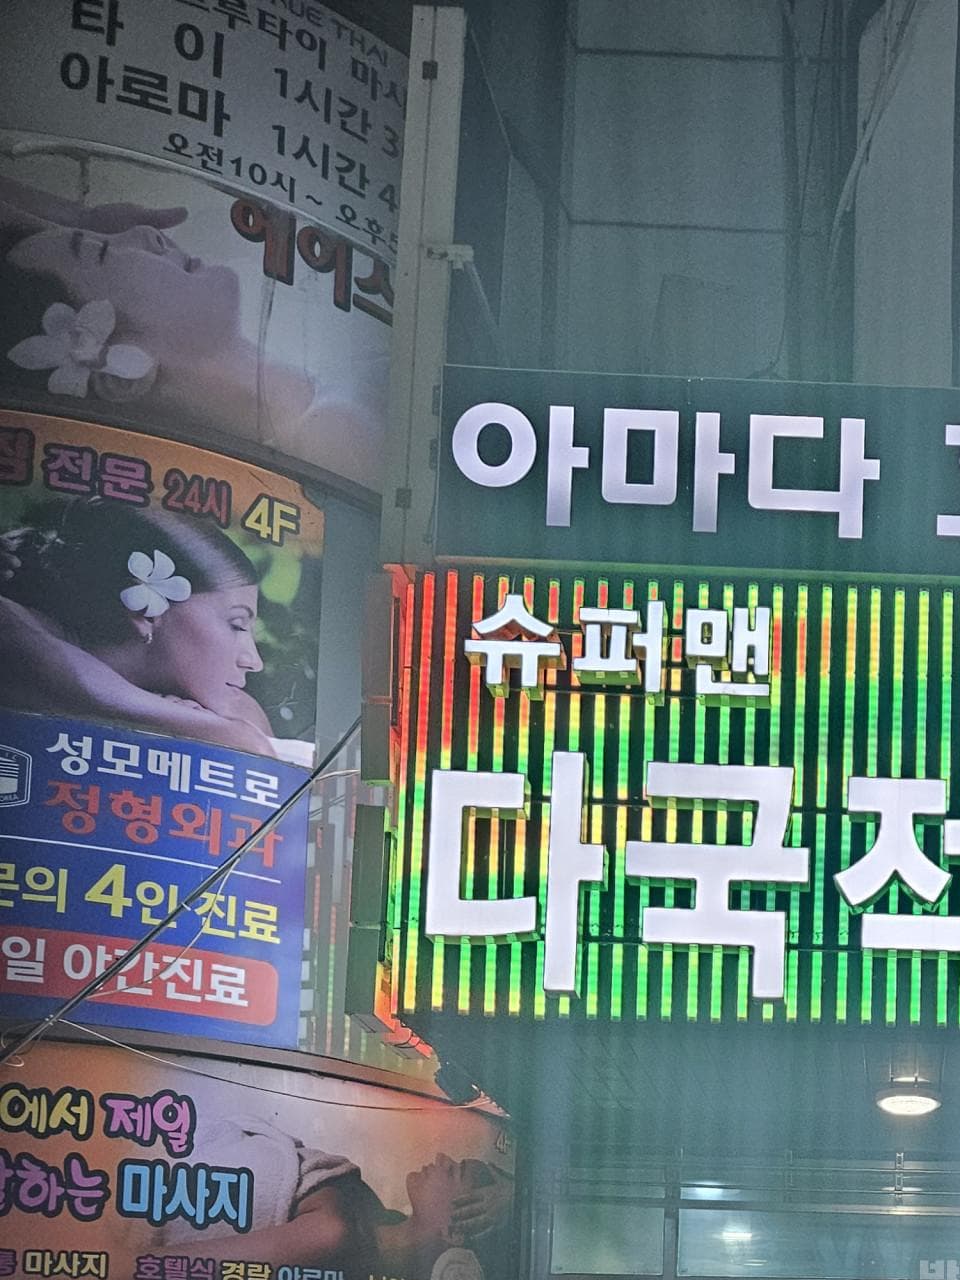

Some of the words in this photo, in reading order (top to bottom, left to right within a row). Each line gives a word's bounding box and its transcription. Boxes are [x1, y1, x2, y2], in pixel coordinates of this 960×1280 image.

[175, 0, 327, 71] 루타이
[330, 18, 388, 67] THAI
[60, 52, 231, 137] 아로마
[271, 124, 370, 199] 1시간
[274, 68, 371, 144] 1시간
[163, 132, 296, 204] 오전10시
[45, 447, 150, 503] 전문
[165, 470, 230, 526] 24시
[245, 497, 299, 543] 4F
[452, 402, 881, 539] 아마다
[464, 593, 770, 697] 슈퍼맨
[46, 732, 282, 808] 성모메트로
[46, 781, 283, 868] 정형외과
[195, 893, 281, 944] 진료
[63, 944, 249, 1007] 야간진료
[105, 1094, 190, 1149] 제일
[122, 1163, 250, 1229] 마사지
[25, 1252, 107, 1279] 마사지
